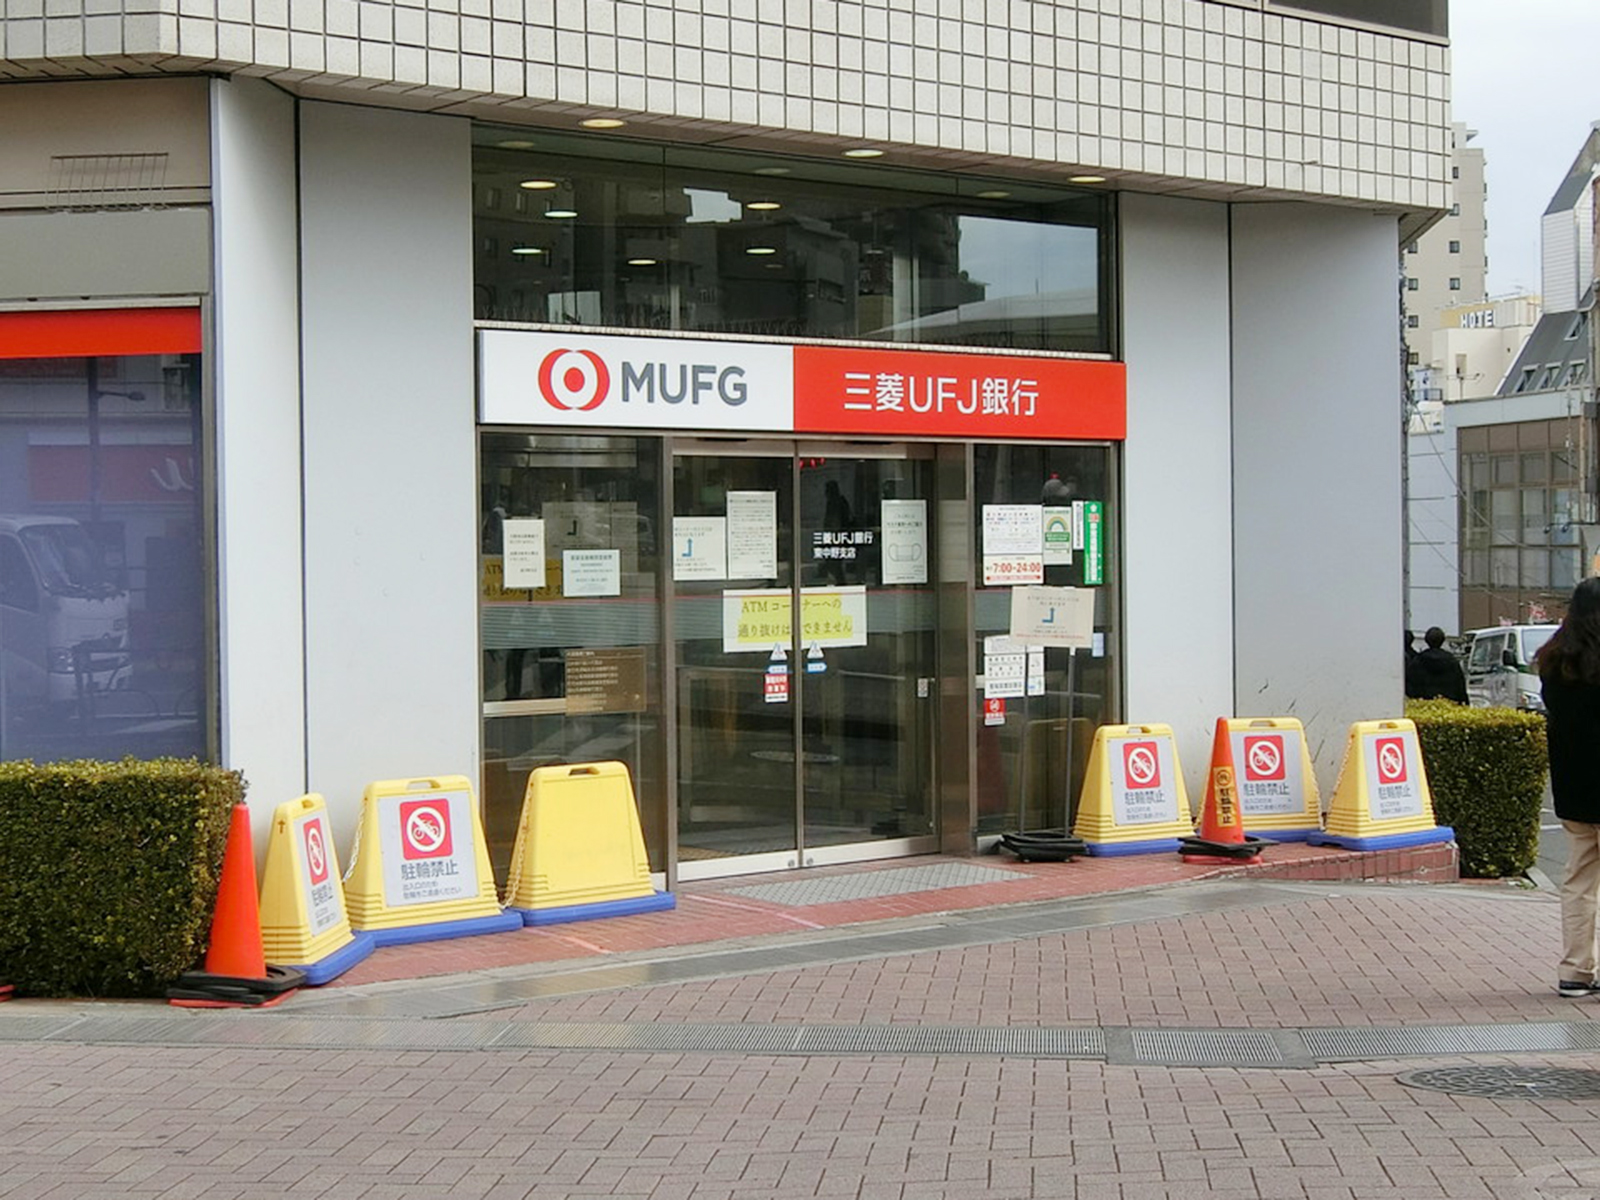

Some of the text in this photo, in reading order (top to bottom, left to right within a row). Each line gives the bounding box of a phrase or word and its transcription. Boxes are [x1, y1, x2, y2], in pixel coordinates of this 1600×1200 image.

[621, 361, 748, 407] MUFG
[843, 371, 1039, 417] 三菱UFJ銀行
[812, 531, 874, 545] 三菱UFJ銀行
[741, 600, 768, 614] ATM
[1124, 789, 1166, 805] 駐輪禁止
[1243, 782, 1291, 796] 駐輪禁止
[400, 859, 459, 880] 駐輪禁止
